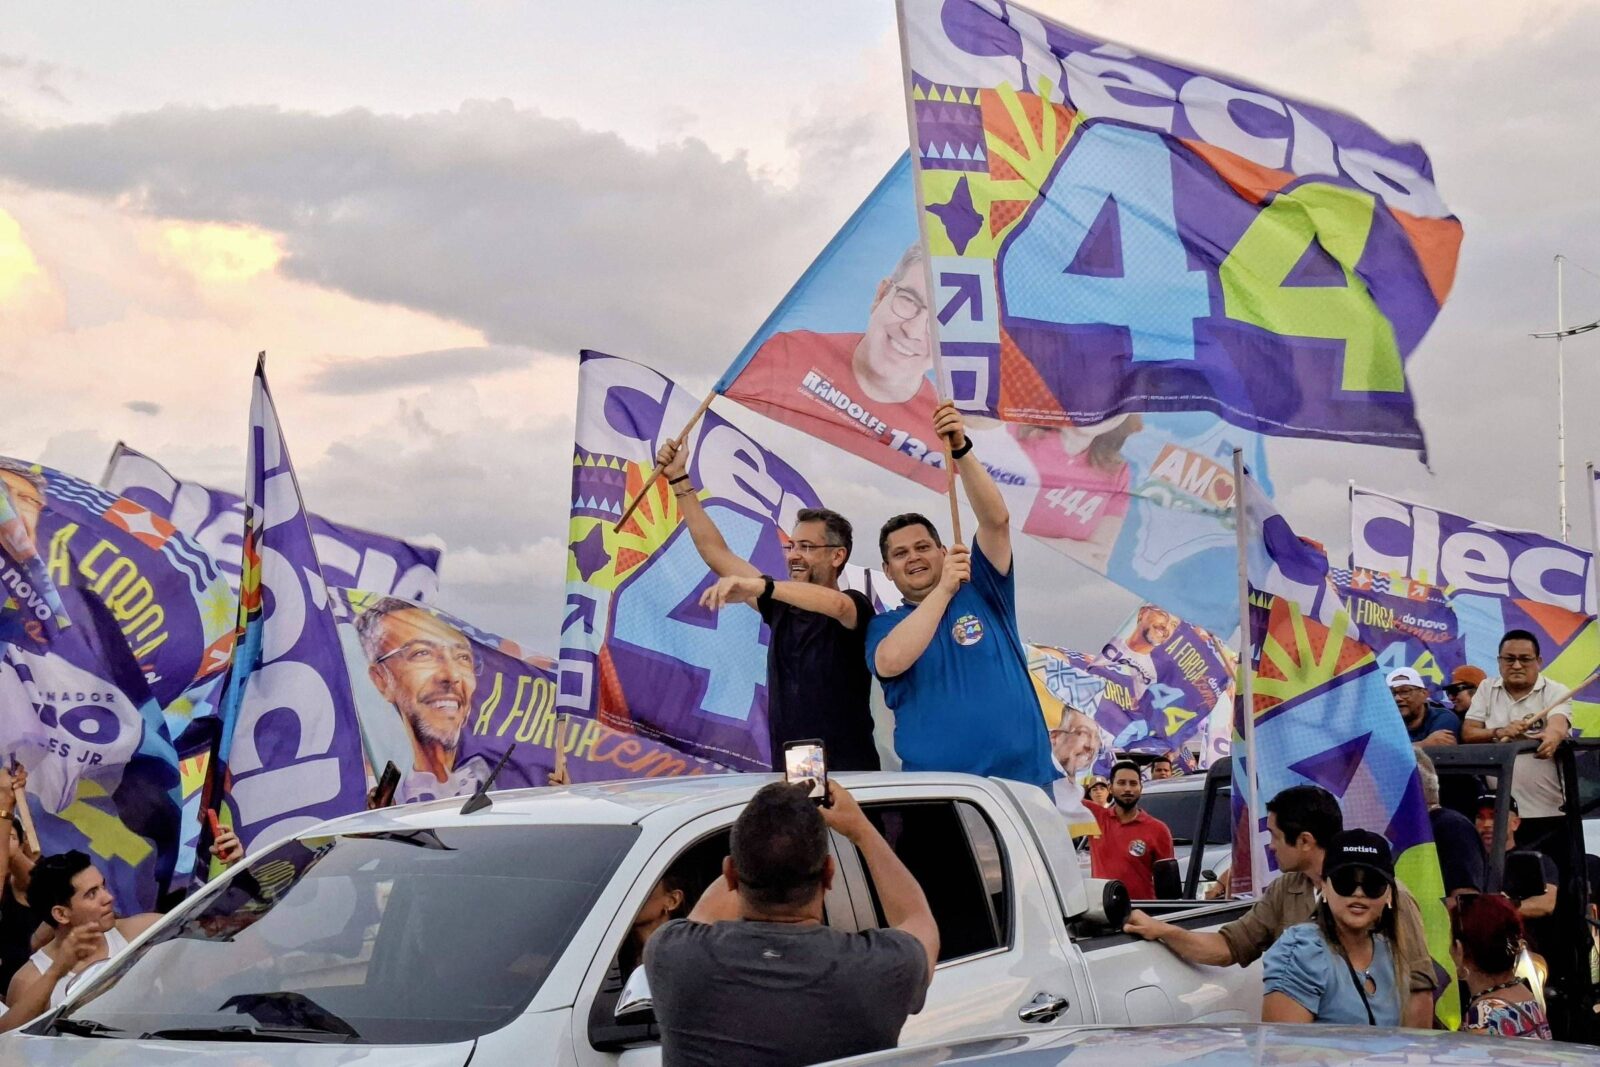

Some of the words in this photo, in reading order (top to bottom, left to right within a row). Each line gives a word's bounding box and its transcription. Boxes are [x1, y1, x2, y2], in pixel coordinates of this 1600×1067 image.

[1002, 122, 1405, 392] 44
[802, 370, 887, 435] RANDOLFE
[1044, 485, 1104, 525] 444
[1, 567, 52, 621] novo
[1356, 597, 1395, 633] FORÇA
[1402, 613, 1415, 625] do
[1417, 618, 1448, 631] novo
[1164, 635, 1185, 656] A
[1172, 641, 1210, 685] FORÇA
[472, 671, 503, 736] A
[77, 750, 103, 766] JR
[1343, 846, 1378, 854] nortista
